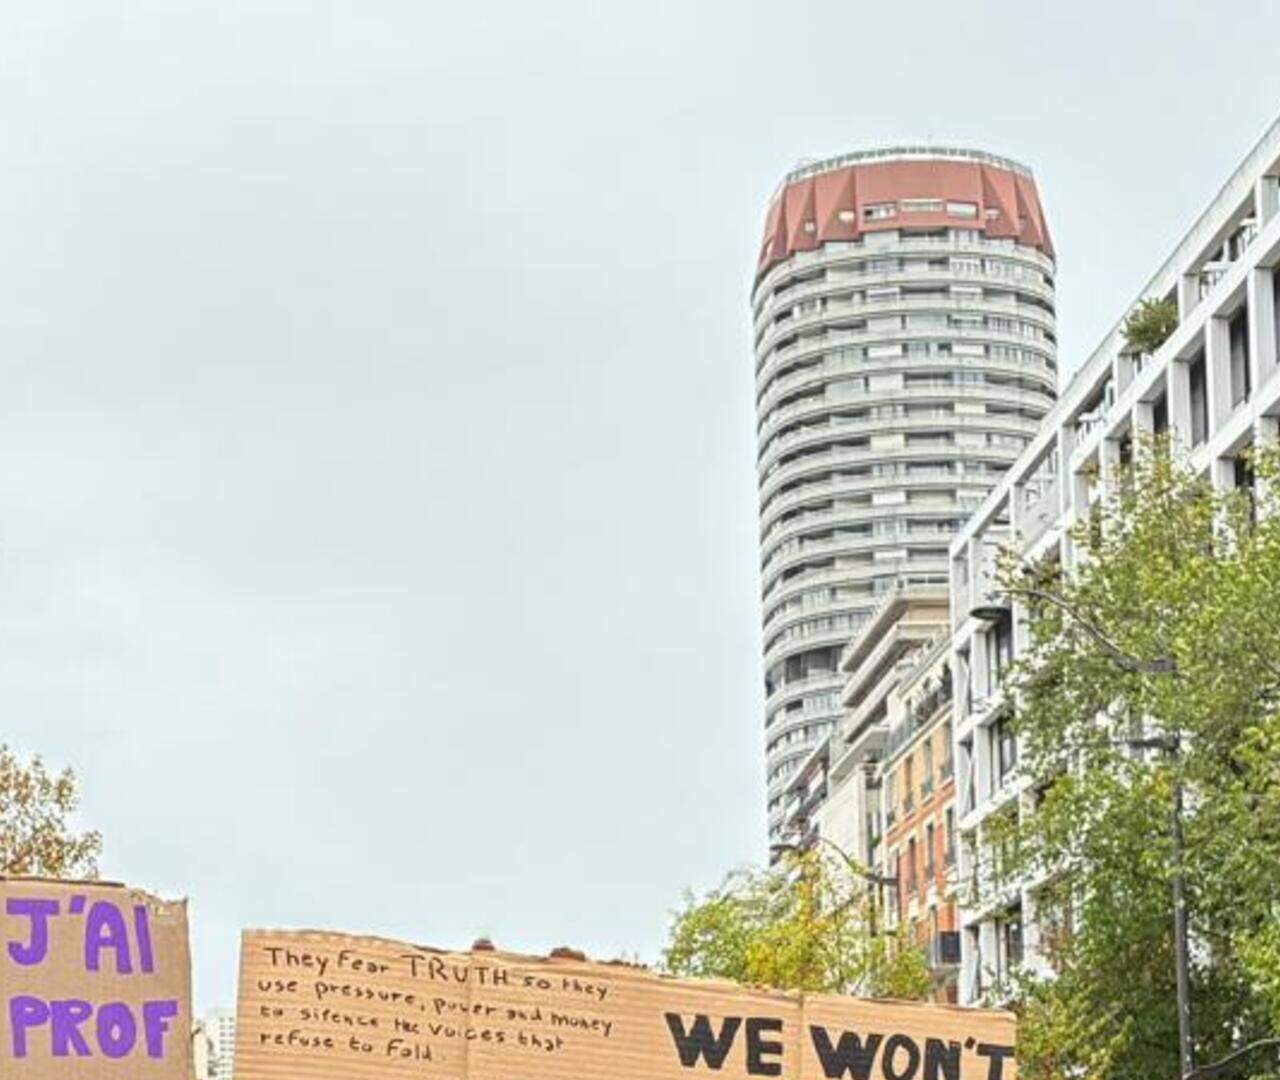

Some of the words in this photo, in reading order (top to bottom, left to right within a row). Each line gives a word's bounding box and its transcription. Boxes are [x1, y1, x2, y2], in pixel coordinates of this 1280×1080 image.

[8, 898, 152, 971] J'AI
[263, 947, 329, 976] They
[401, 954, 509, 985] TRUTH
[523, 976, 551, 989] so
[562, 977, 608, 1001] they
[11, 996, 178, 1057] PROF
[258, 980, 298, 993] use
[433, 998, 497, 1016] power
[505, 1007, 543, 1022] and
[550, 1012, 613, 1037] money
[260, 1005, 284, 1017] to
[428, 1023, 506, 1044] voices
[517, 1031, 565, 1052] that
[260, 1029, 335, 1048] refuse
[349, 1036, 374, 1053] to
[664, 1011, 785, 1077] WE
